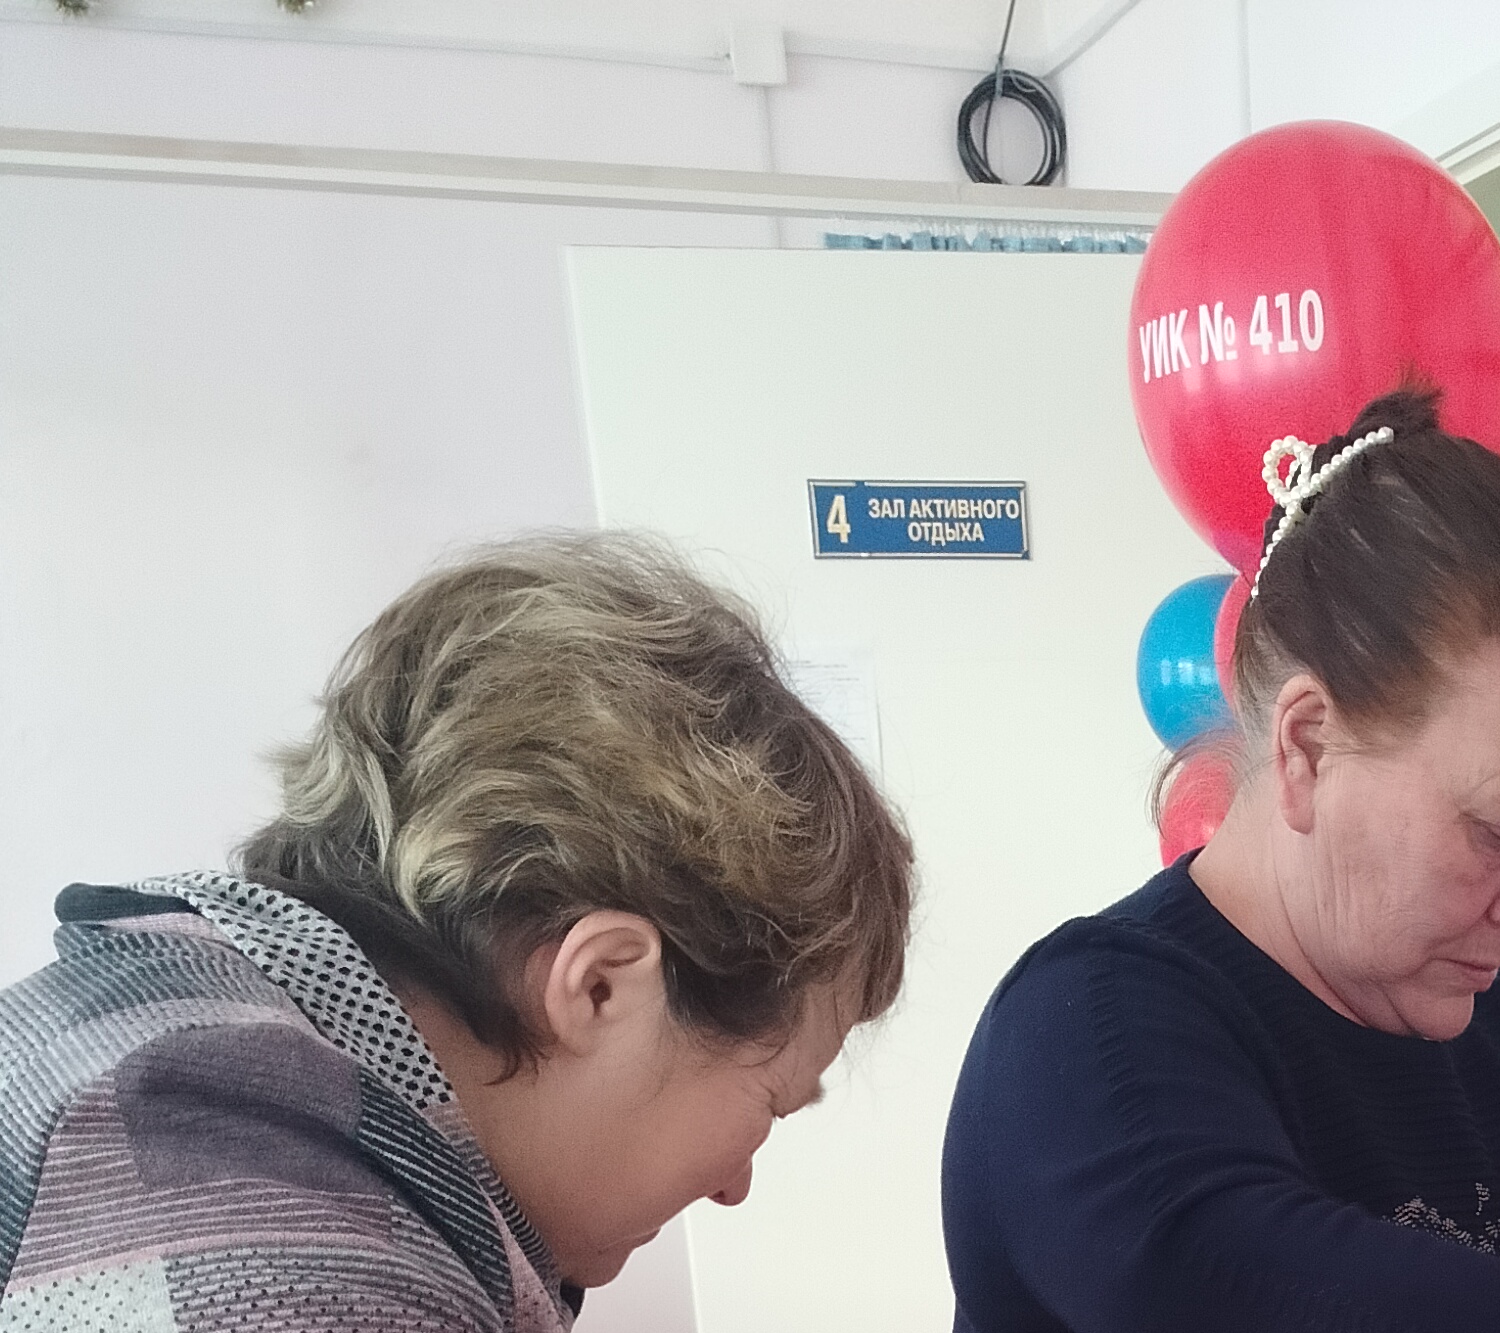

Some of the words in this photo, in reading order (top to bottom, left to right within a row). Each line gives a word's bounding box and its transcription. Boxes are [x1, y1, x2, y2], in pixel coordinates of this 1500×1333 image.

[1138, 308, 1192, 384] УИК
[1198, 300, 1238, 365] №
[1249, 288, 1325, 355] 410
[826, 494, 851, 544] 4
[867, 498, 906, 519] ЗАЛ
[908, 498, 1019, 520] АКТИВНОГО
[907, 521, 985, 547] ОТДЫХА
